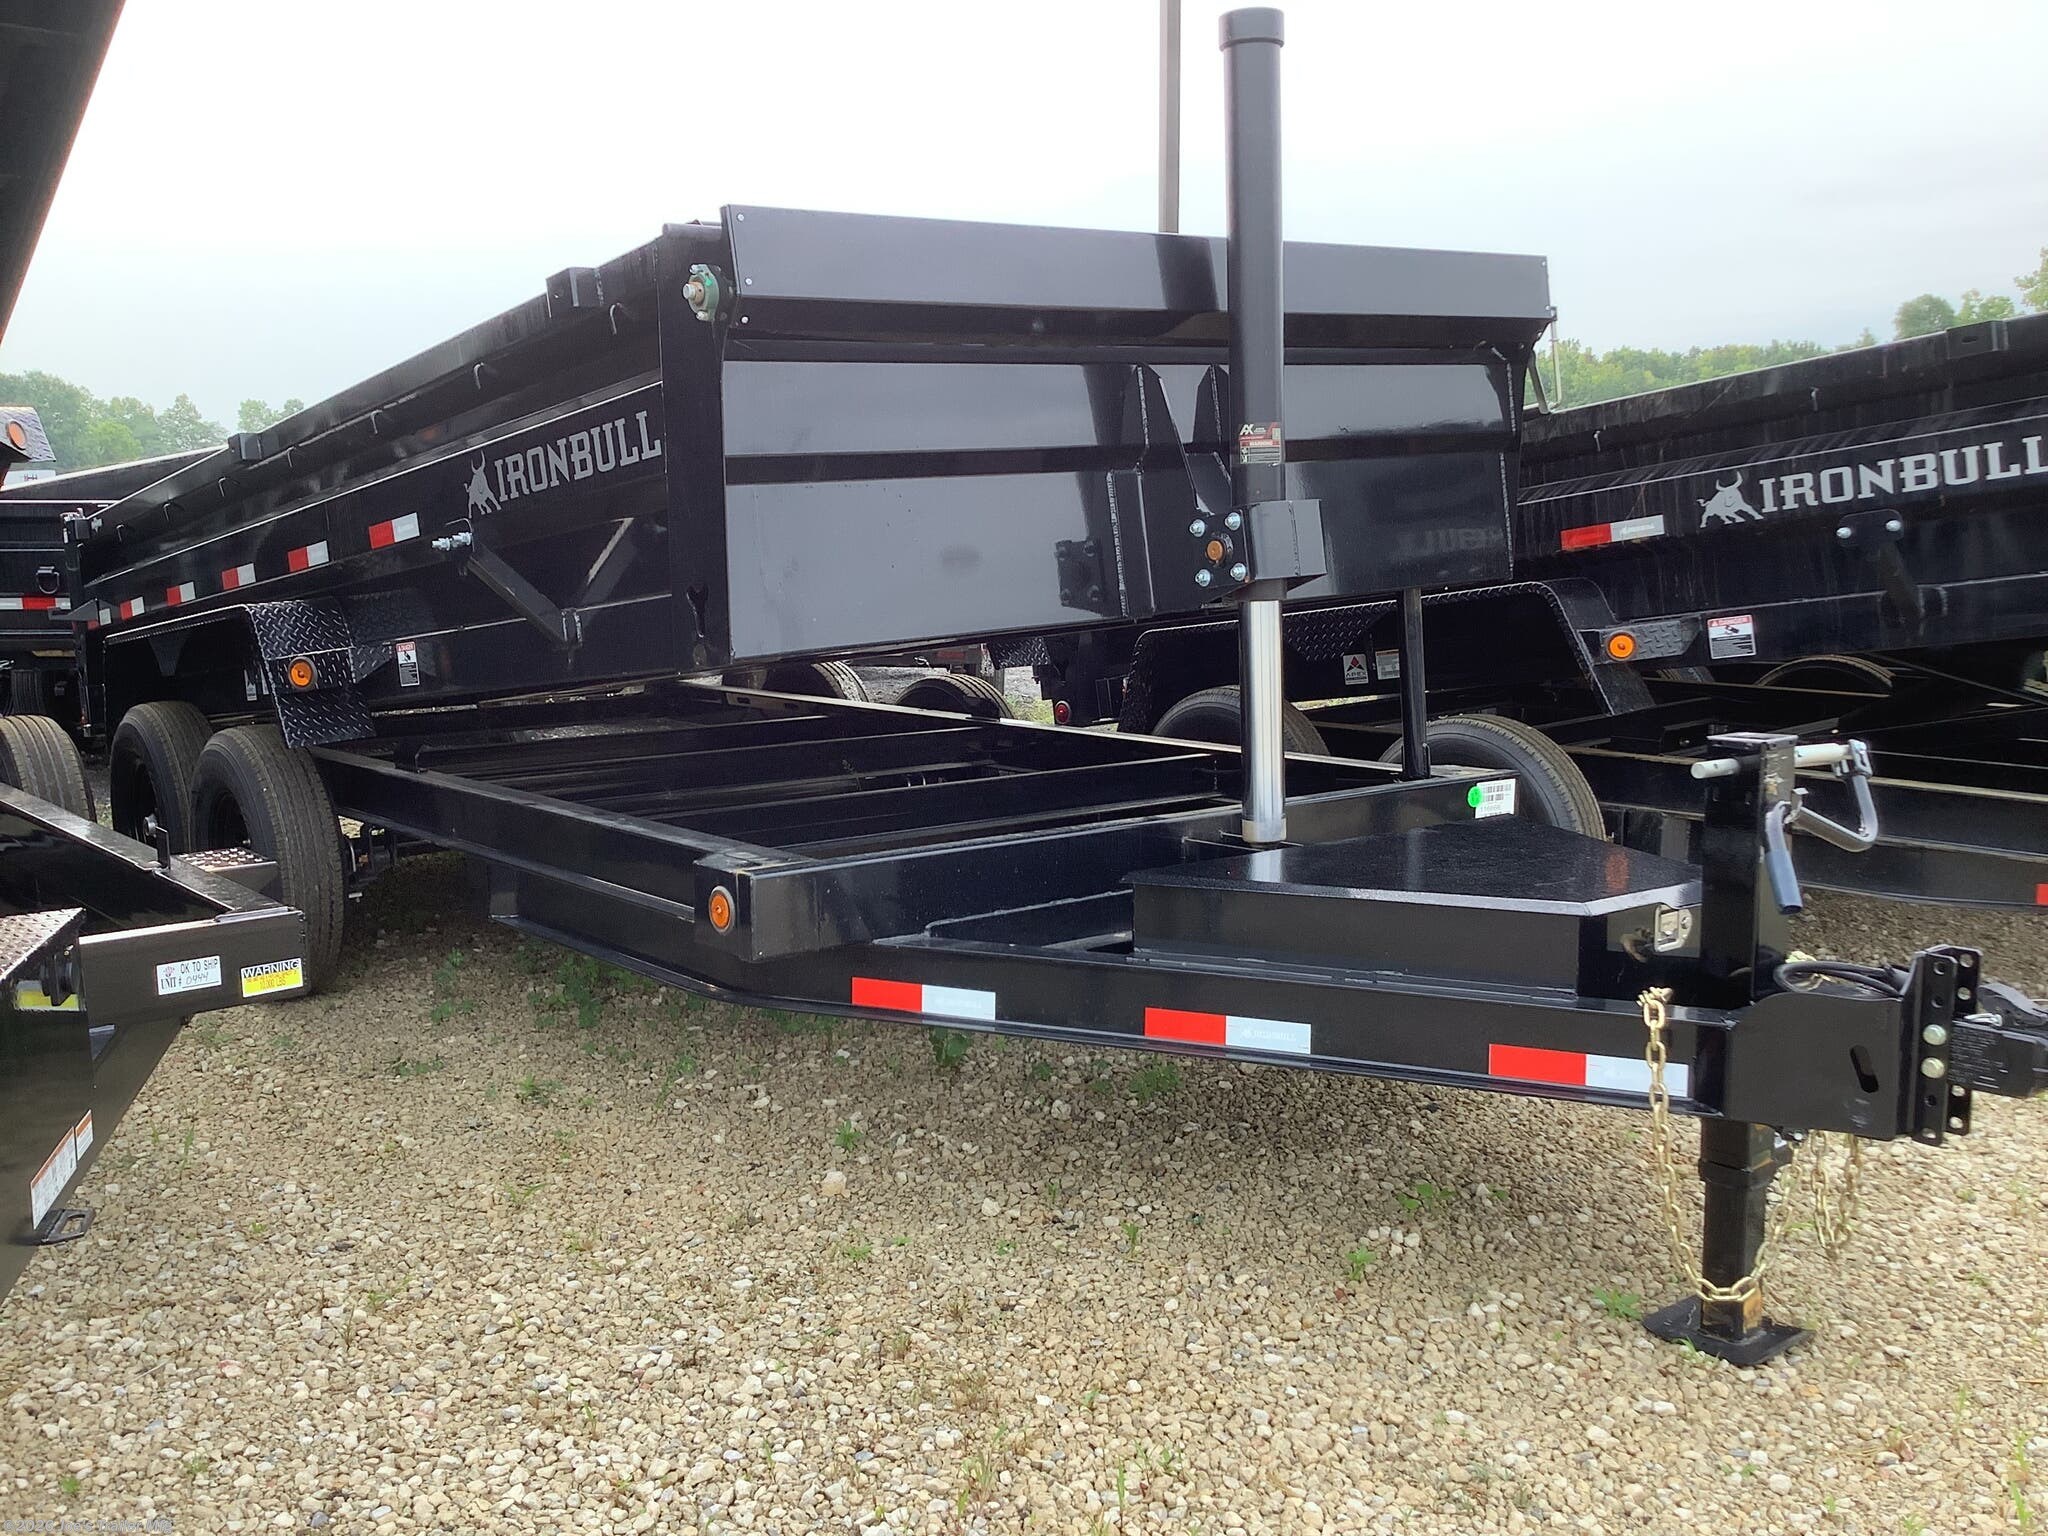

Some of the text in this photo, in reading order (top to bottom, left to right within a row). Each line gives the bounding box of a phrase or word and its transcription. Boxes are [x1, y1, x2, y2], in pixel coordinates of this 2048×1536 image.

[493, 410, 662, 502] IRONBULL
[1759, 435, 2048, 513] IRONBULL
[180, 958, 219, 975] OK TO SHIP
[243, 959, 300, 979] WARNING
[160, 977, 177, 990] UNIT
